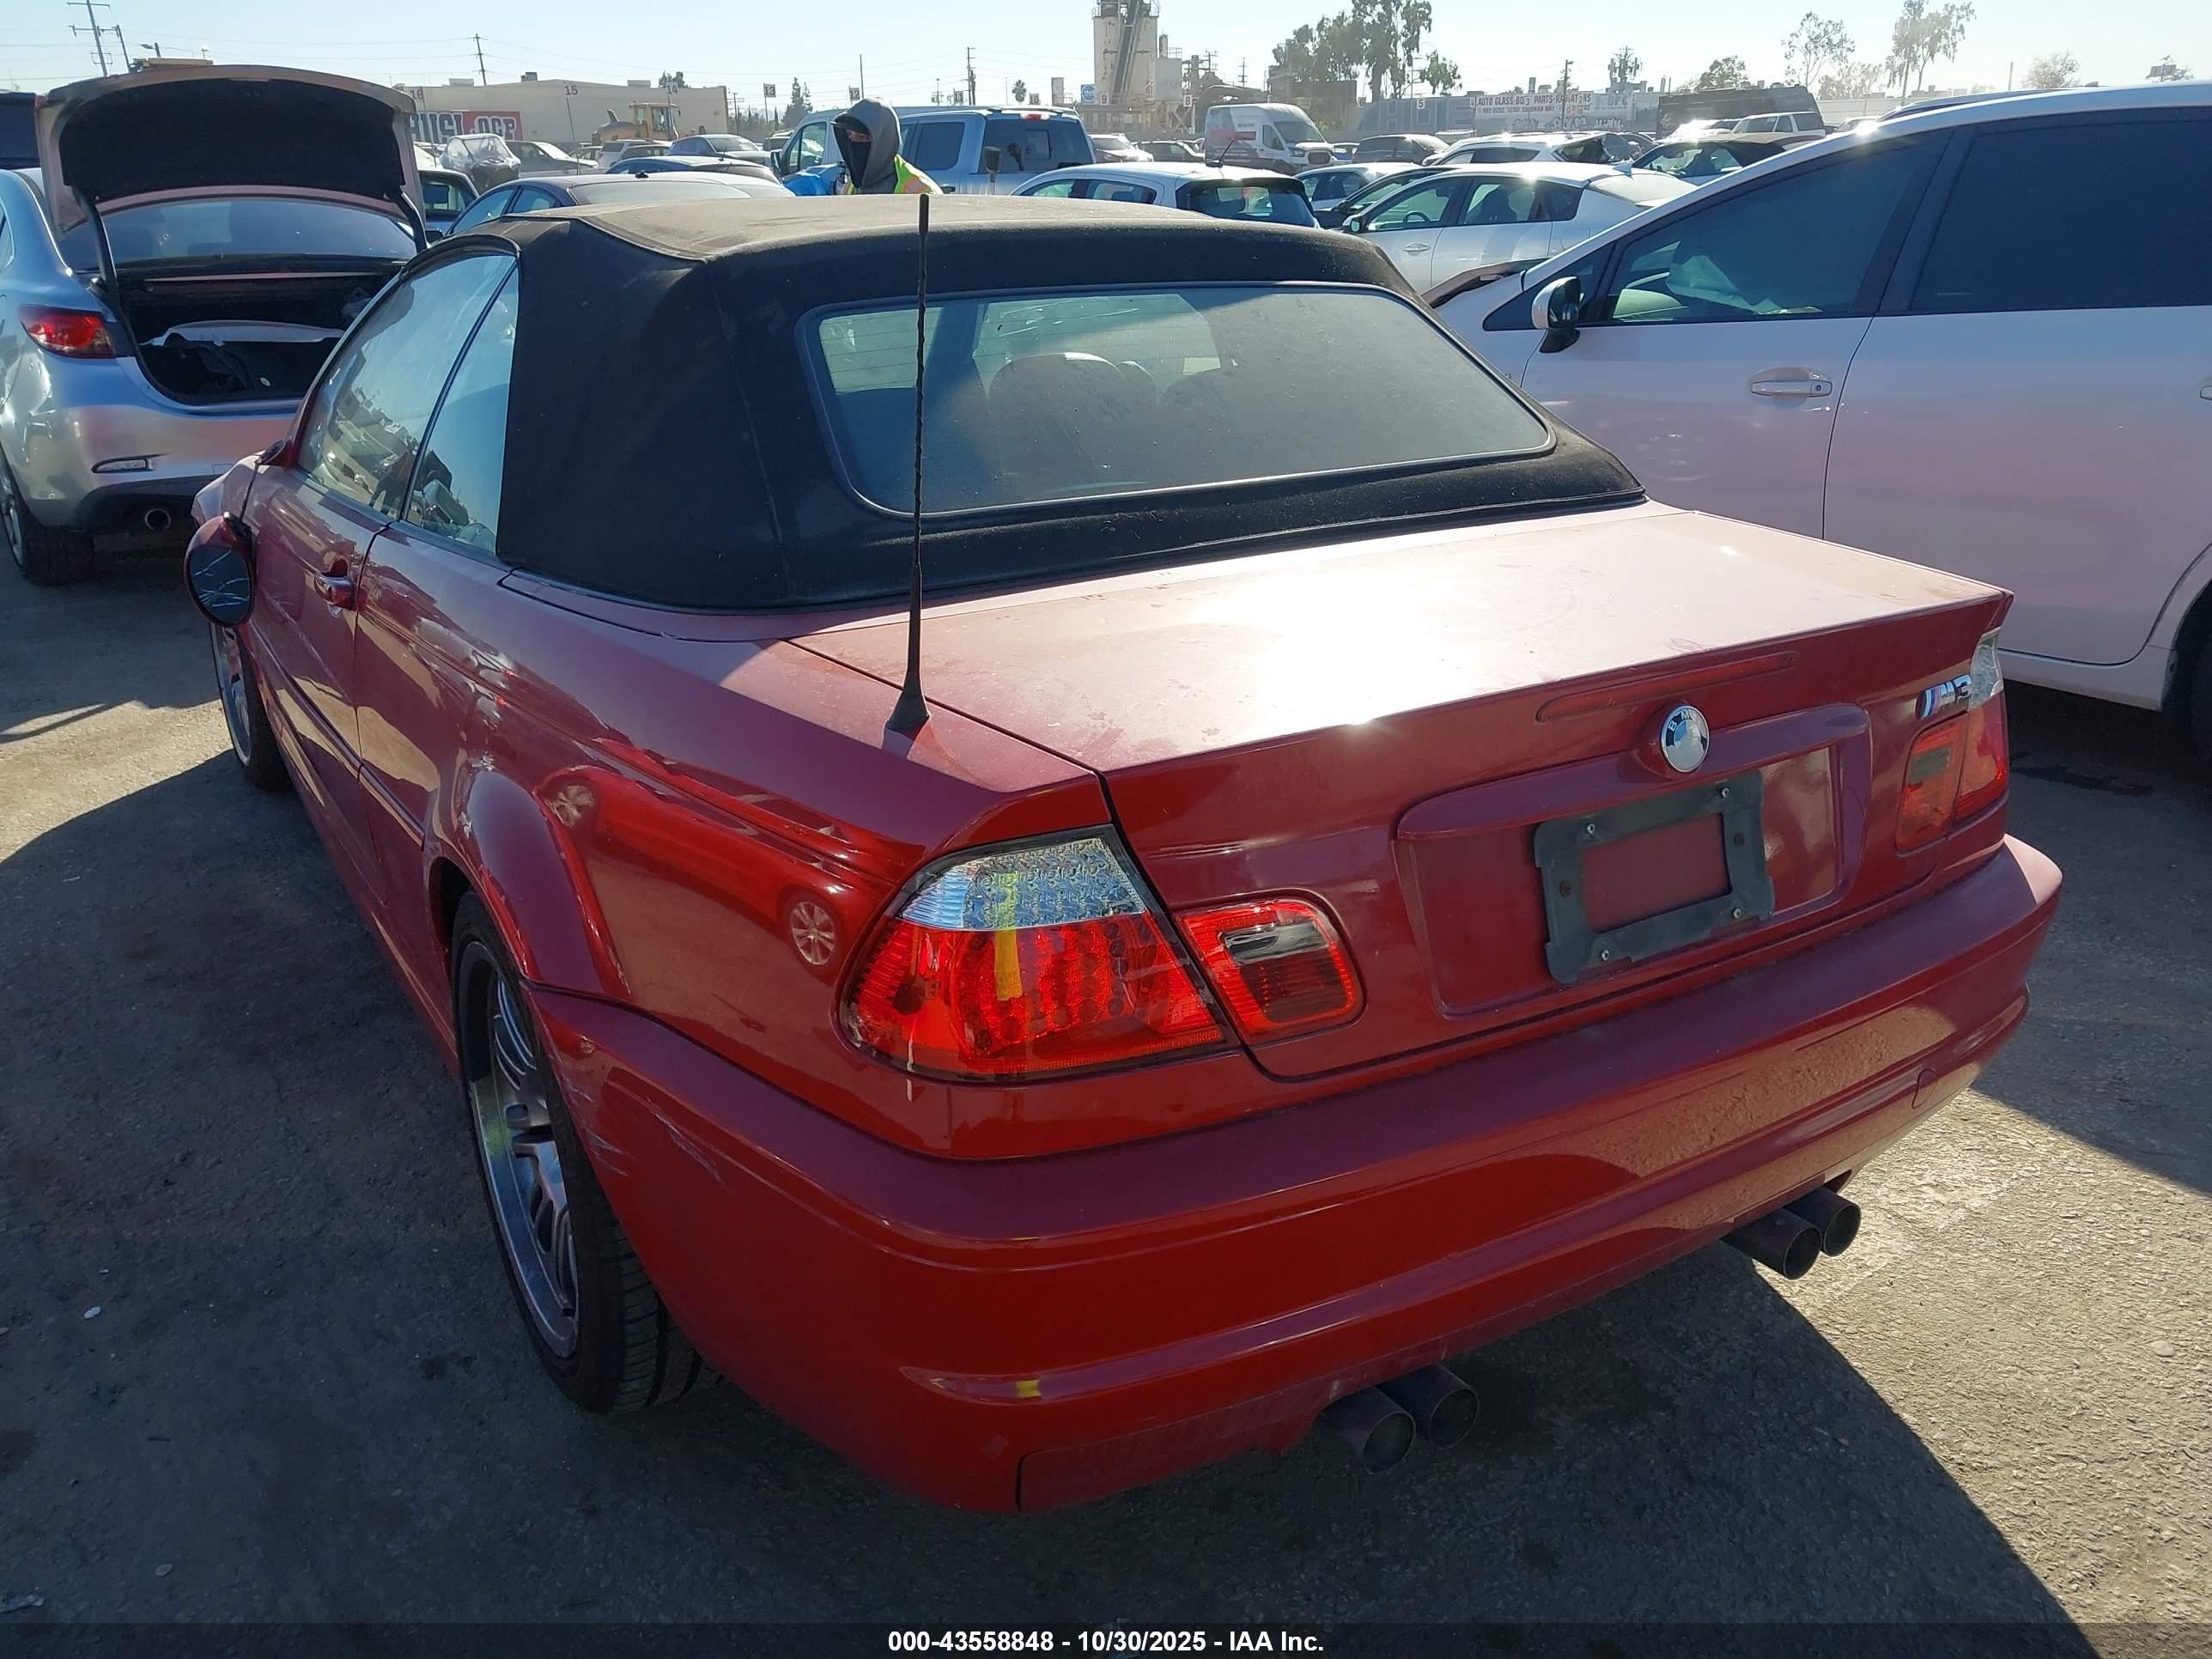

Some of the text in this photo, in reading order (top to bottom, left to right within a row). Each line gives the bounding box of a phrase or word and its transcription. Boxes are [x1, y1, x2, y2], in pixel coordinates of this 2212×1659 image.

[564, 85, 578, 96] 15
[666, 84, 678, 94] 14
[764, 86, 775, 96] 13
[849, 89, 860, 99] 12
[1030, 95, 1039, 105] 10
[1101, 94, 1107, 104] 9
[1185, 96, 1190, 106] 8
[1418, 99, 1424, 108] 5
[1478, 97, 1493, 106] AUTO
[1525, 97, 1530, 106] 3
